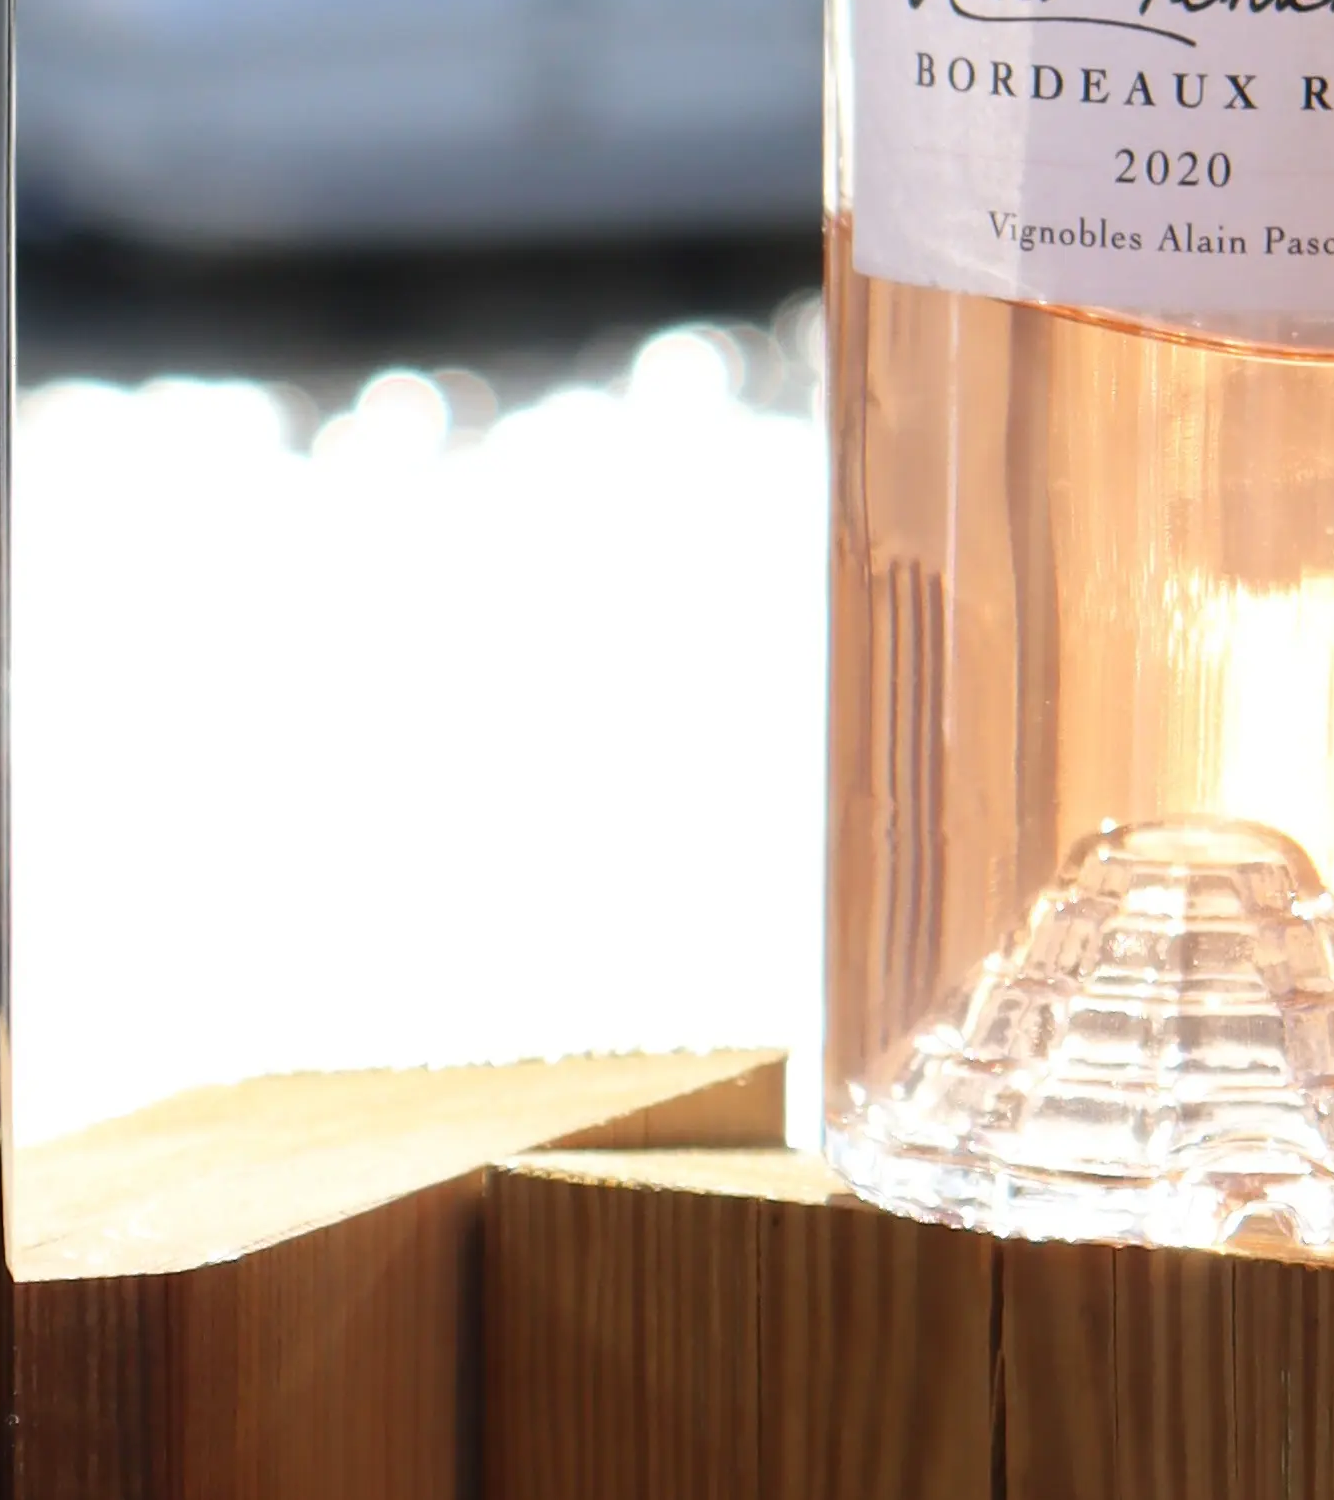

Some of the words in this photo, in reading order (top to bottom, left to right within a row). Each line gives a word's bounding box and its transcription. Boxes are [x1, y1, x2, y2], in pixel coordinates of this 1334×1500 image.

[915, 51, 1259, 110] BORDEAUX
[1114, 147, 1233, 188] 2020
[987, 210, 1143, 252] Vignobles
[1157, 221, 1248, 255] Alain
